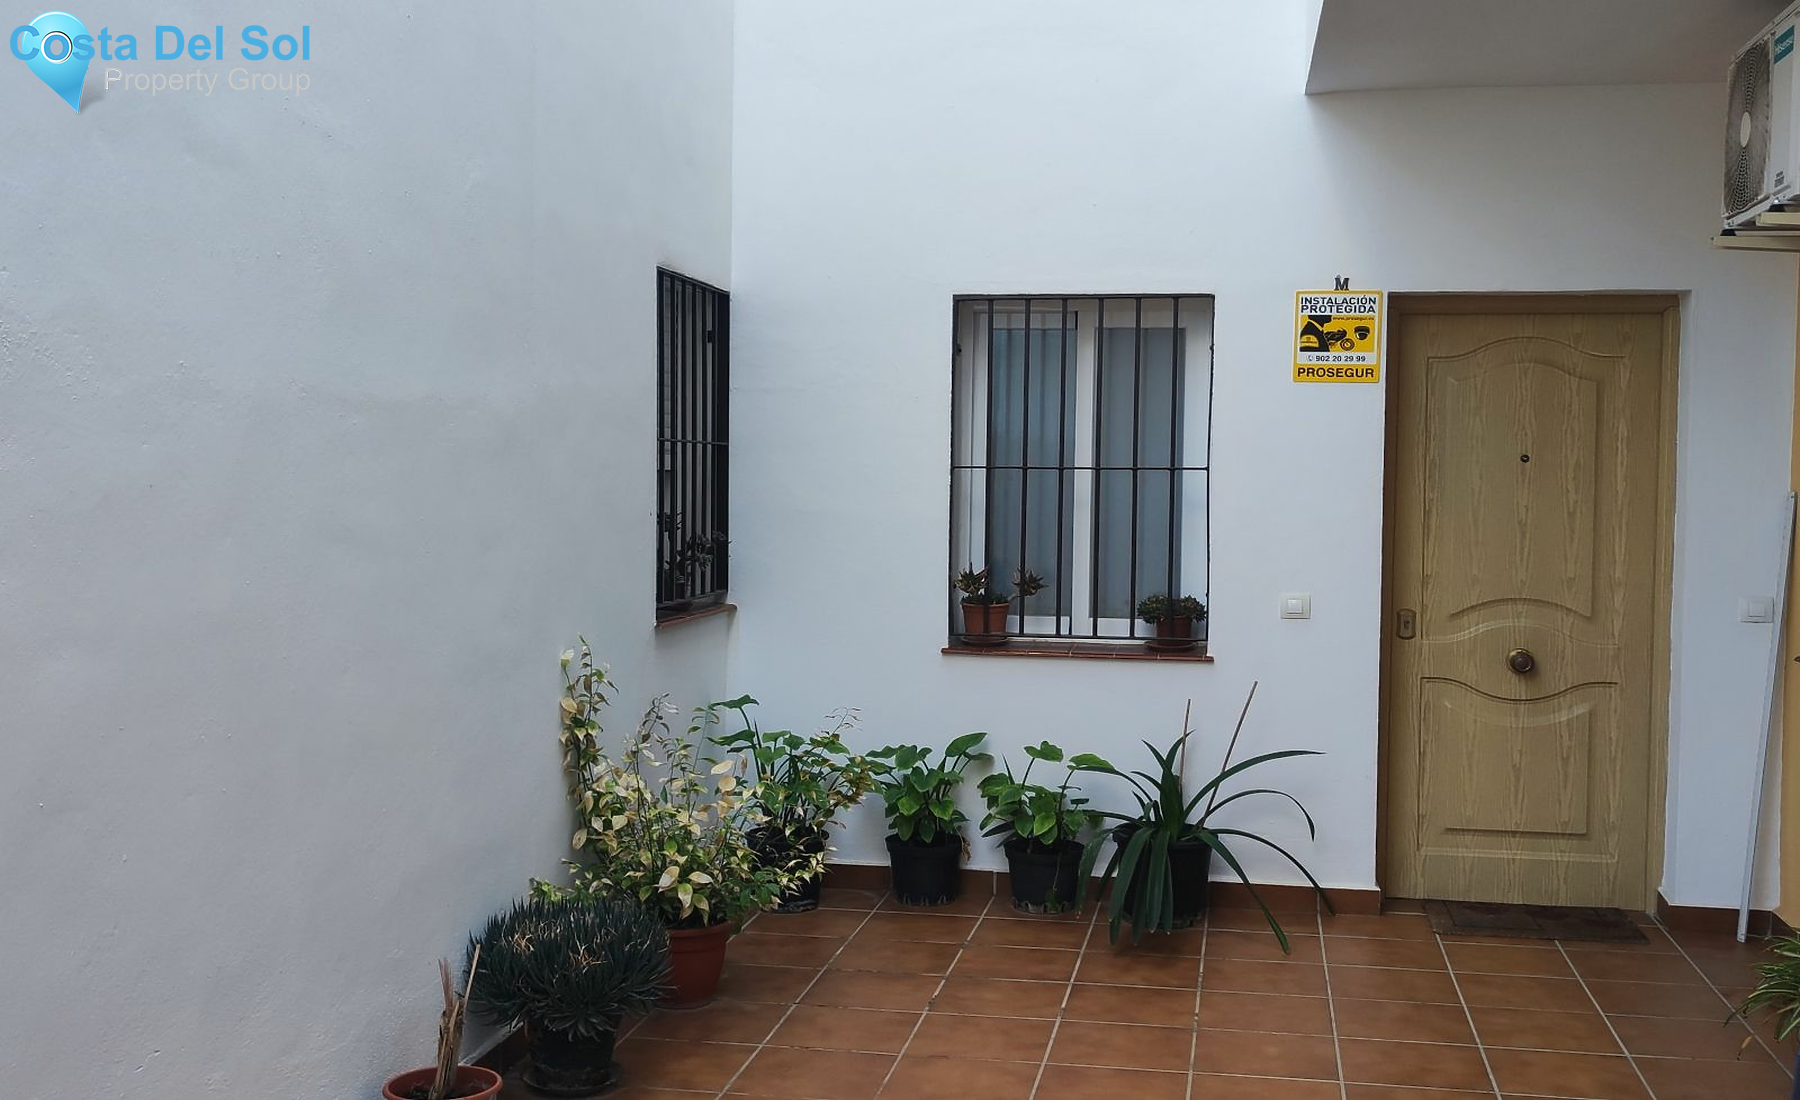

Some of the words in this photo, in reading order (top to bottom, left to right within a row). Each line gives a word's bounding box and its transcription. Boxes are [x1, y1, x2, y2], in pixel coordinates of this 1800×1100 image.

[1300, 295, 1376, 305] INSTALACIÓN
[1300, 305, 1376, 314] PROTEGIDA
[1297, 367, 1374, 378] PROSEGUR
